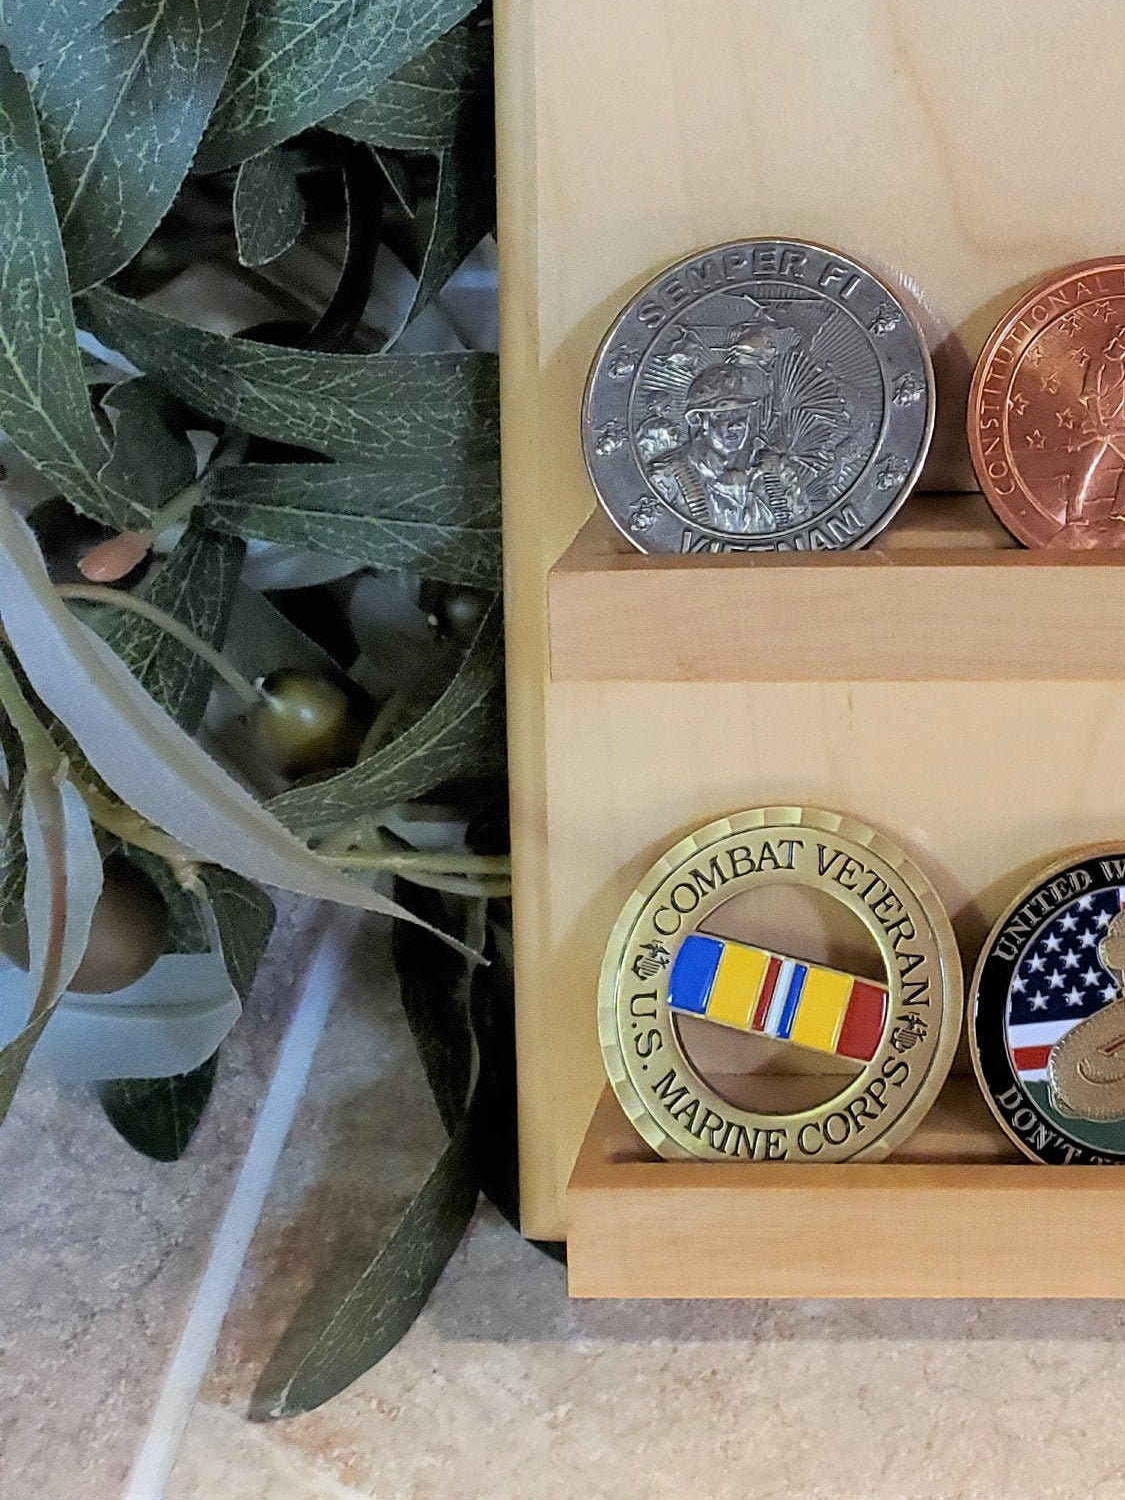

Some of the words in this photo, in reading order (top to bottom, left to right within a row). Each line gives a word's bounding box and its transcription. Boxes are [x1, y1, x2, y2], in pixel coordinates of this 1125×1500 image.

[638, 250, 808, 329] SEMPER
[819, 263, 862, 299] FI
[979, 278, 1110, 496] CONSTITUTIONAL
[652, 839, 805, 936] COMBAT
[815, 843, 931, 1009] VETERAN
[991, 868, 1093, 964] UNITED
[629, 988, 664, 1071] U.S.
[651, 1068, 788, 1162] MARINE
[797, 1055, 911, 1156] CORPS
[994, 1083, 1083, 1165] DON'T
